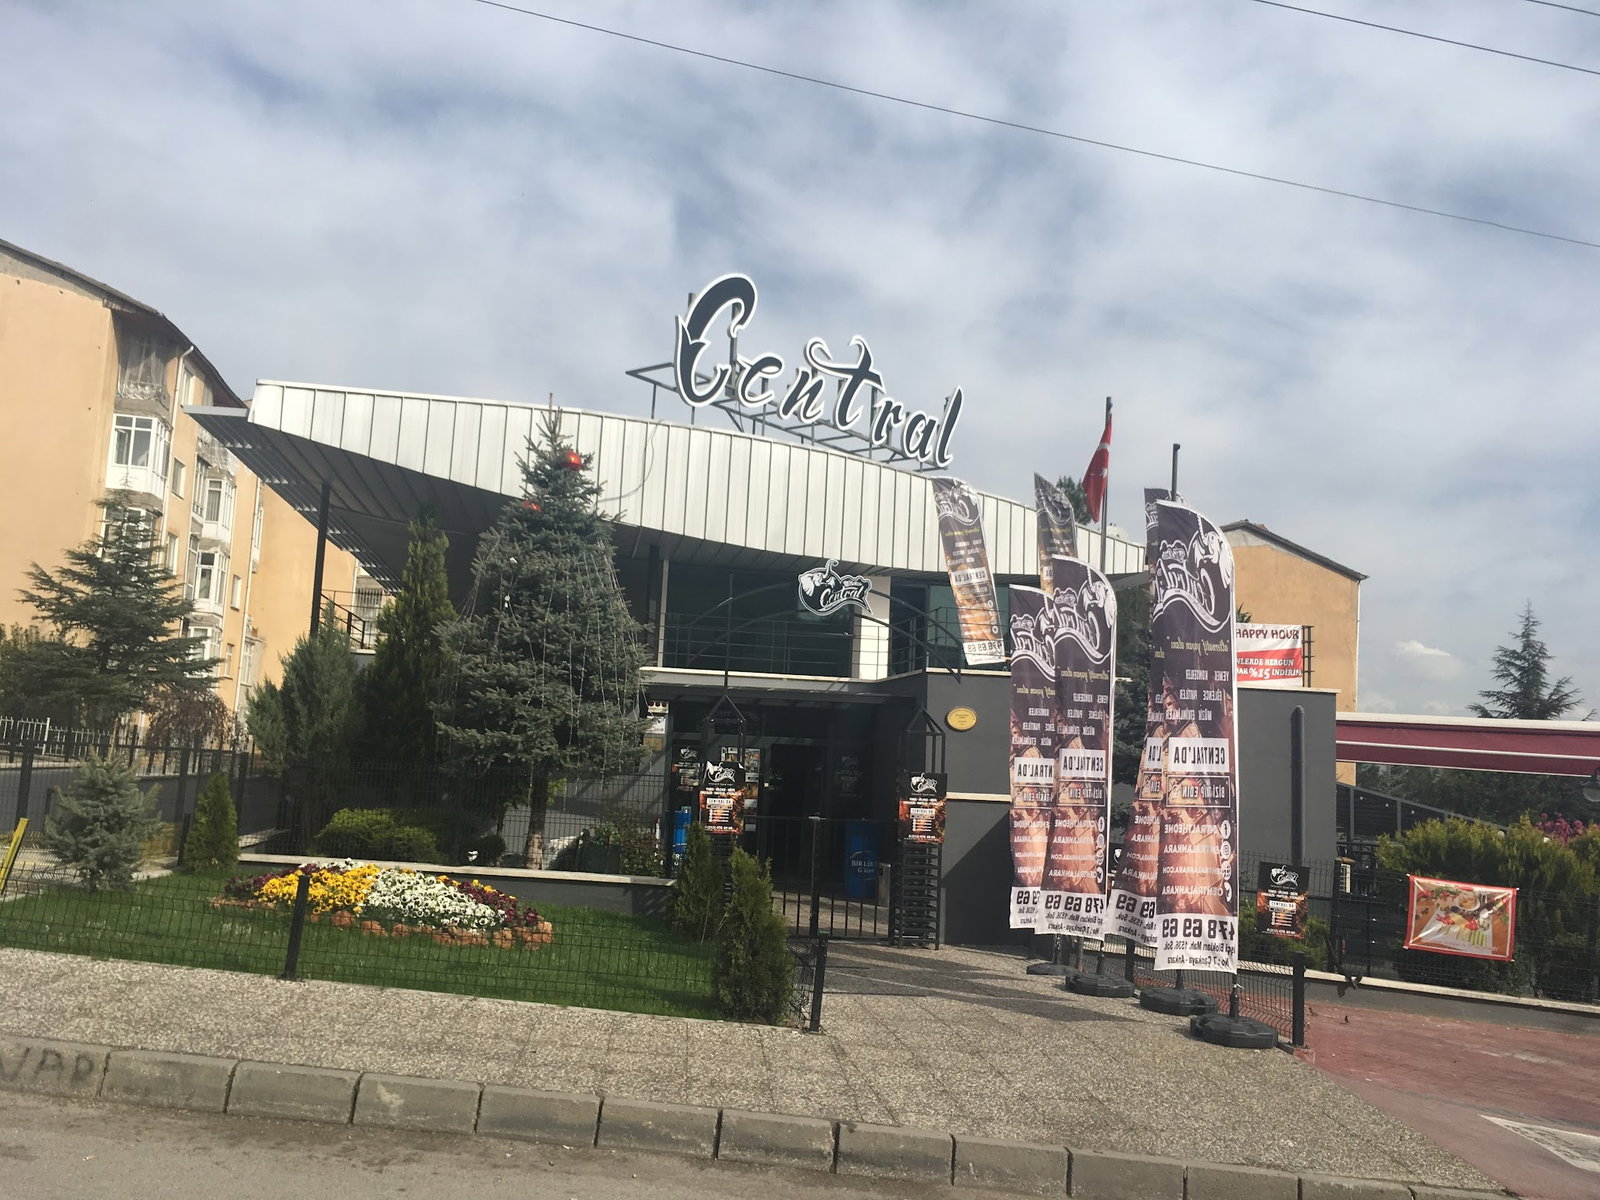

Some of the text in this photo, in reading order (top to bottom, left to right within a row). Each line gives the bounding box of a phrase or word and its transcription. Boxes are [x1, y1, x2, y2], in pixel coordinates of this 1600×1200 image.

[674, 272, 964, 467] Central
[820, 585, 864, 608] Central
[1236, 628, 1300, 640] HAPPY HOUR
[1248, 667, 1271, 680] %15
